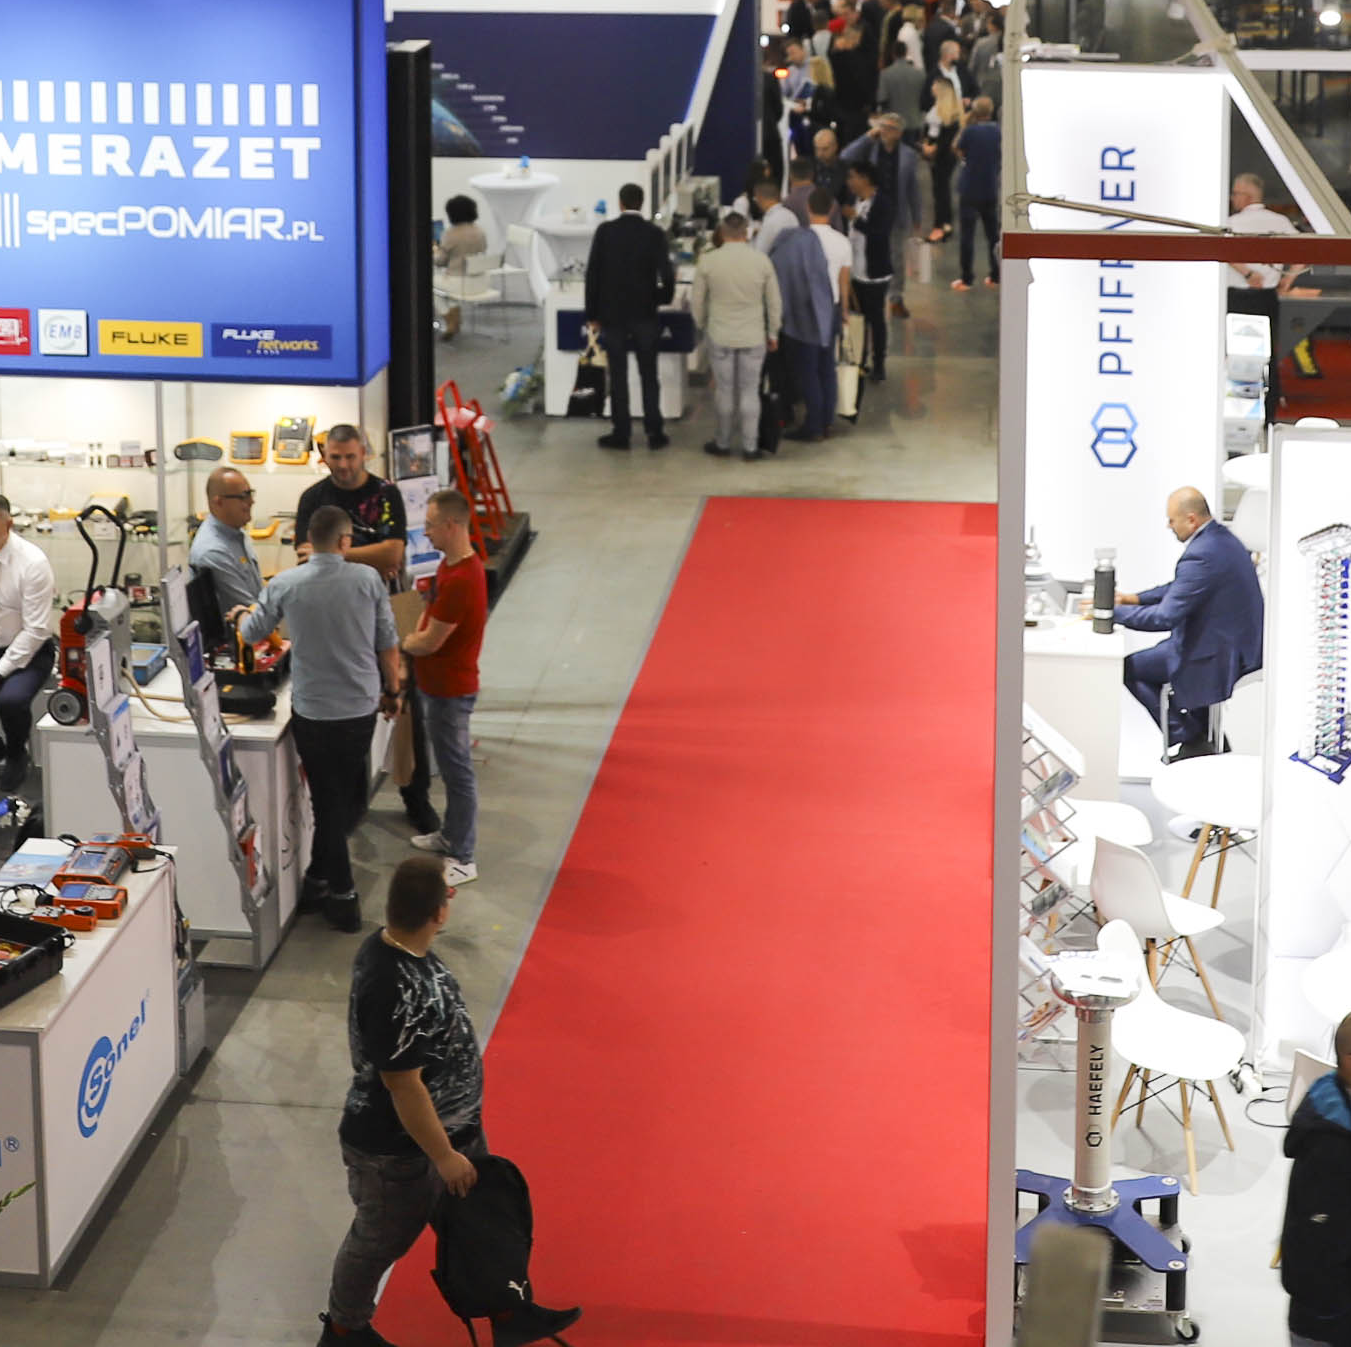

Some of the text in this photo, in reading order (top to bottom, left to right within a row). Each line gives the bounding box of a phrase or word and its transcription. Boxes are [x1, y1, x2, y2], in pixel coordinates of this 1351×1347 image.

[26, 205, 324, 241] specPOMIAR.PL
[1098, 145, 1136, 376] PFIFER
[111, 331, 189, 346] FLUKE
[256, 338, 320, 352] networks
[1088, 1043, 1103, 1116] HAEFELY
